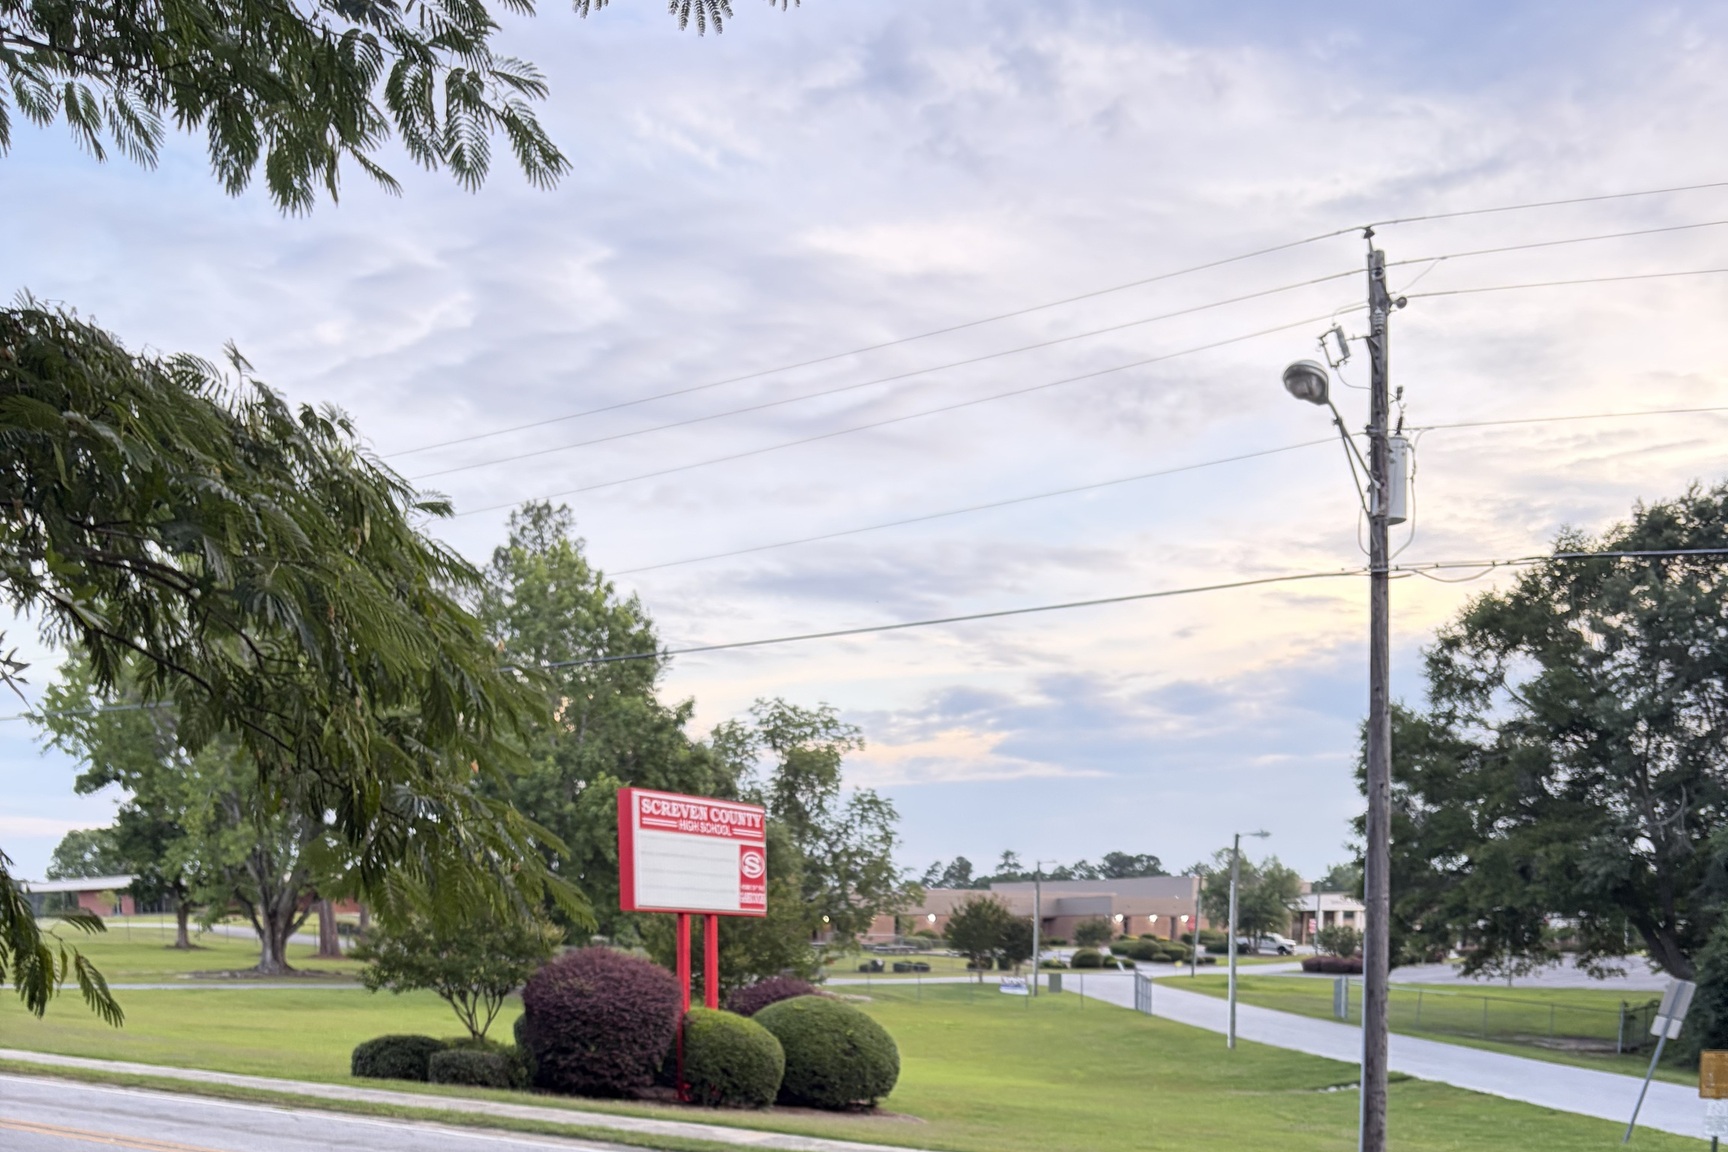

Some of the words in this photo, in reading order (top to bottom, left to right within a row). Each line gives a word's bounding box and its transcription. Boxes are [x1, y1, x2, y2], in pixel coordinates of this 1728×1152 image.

[641, 798, 708, 821] SCREVEN
[709, 808, 762, 828] COUNTY
[679, 819, 699, 832] HIGH
[700, 821, 732, 836] SCHOOL
[743, 856, 762, 873] S
